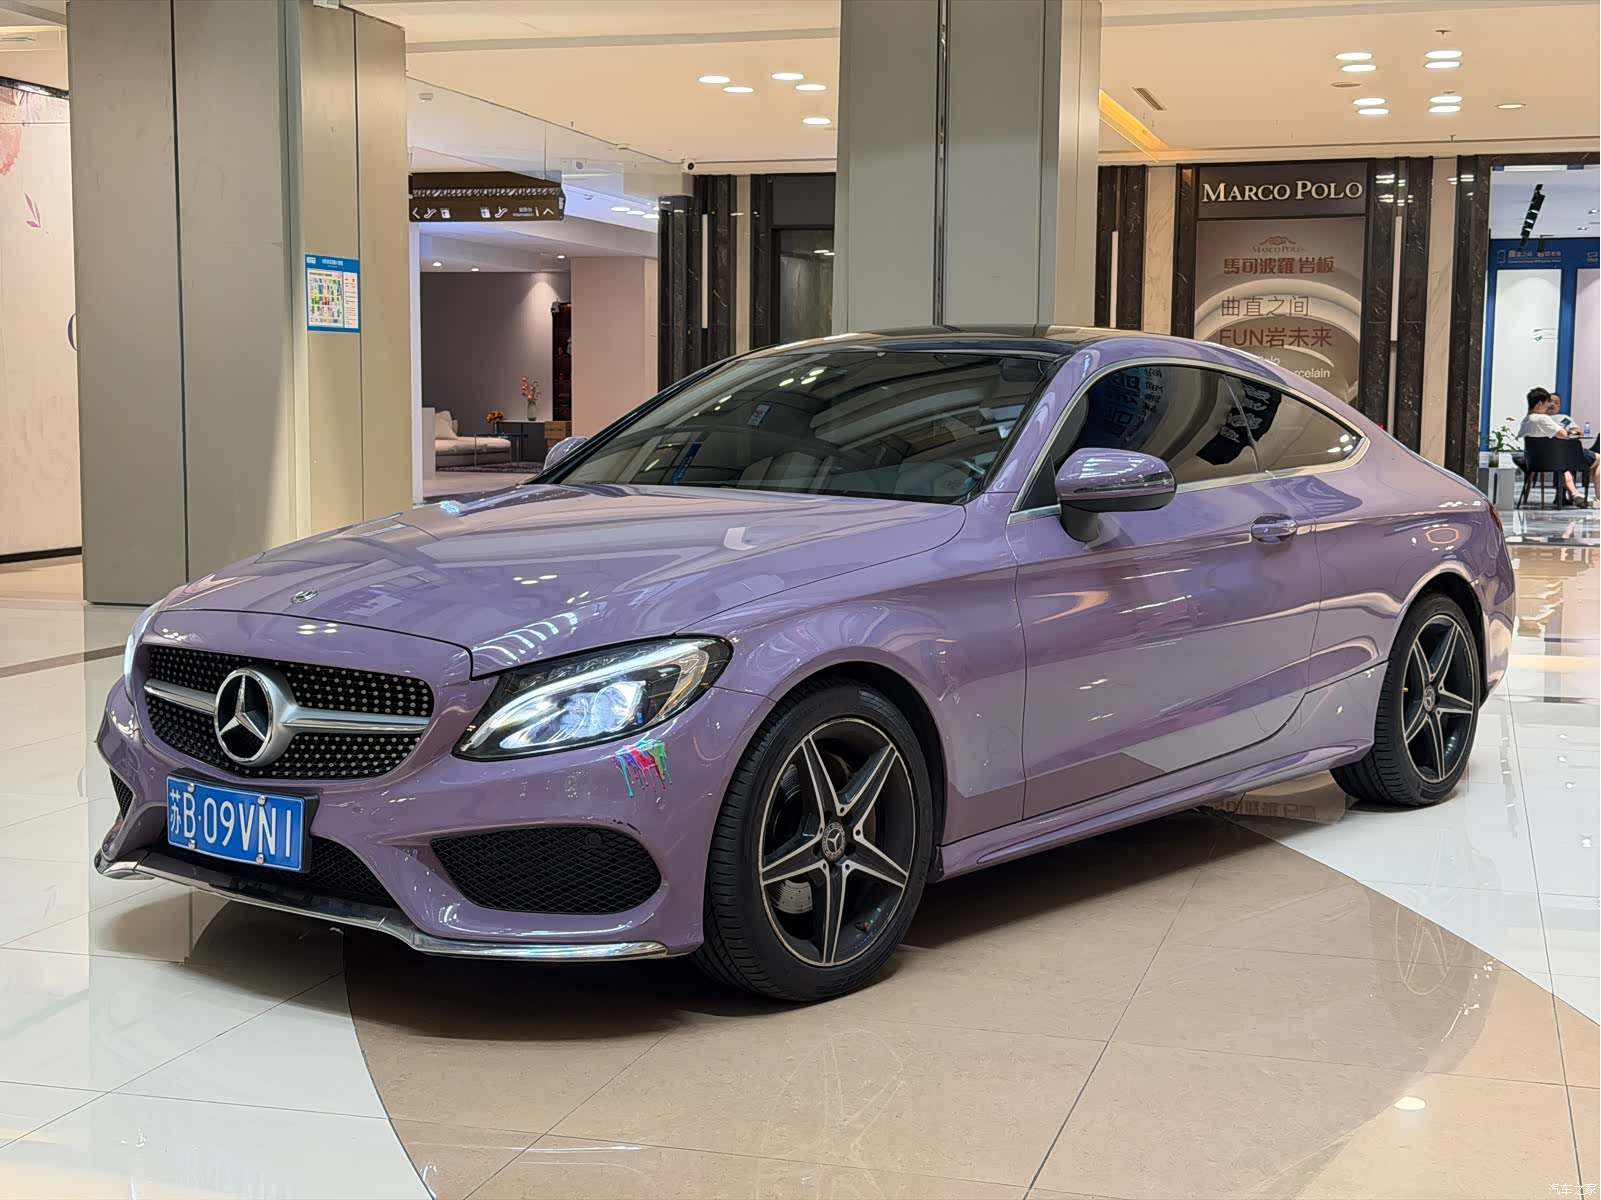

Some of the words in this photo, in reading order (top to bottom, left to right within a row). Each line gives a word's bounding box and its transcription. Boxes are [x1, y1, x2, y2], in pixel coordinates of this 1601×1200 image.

[1202, 183, 1291, 202] MARCO
[1295, 180, 1363, 200] POLO
[1221, 296, 1309, 317] 曲直之间
[1294, 368, 1331, 378] rcelain
